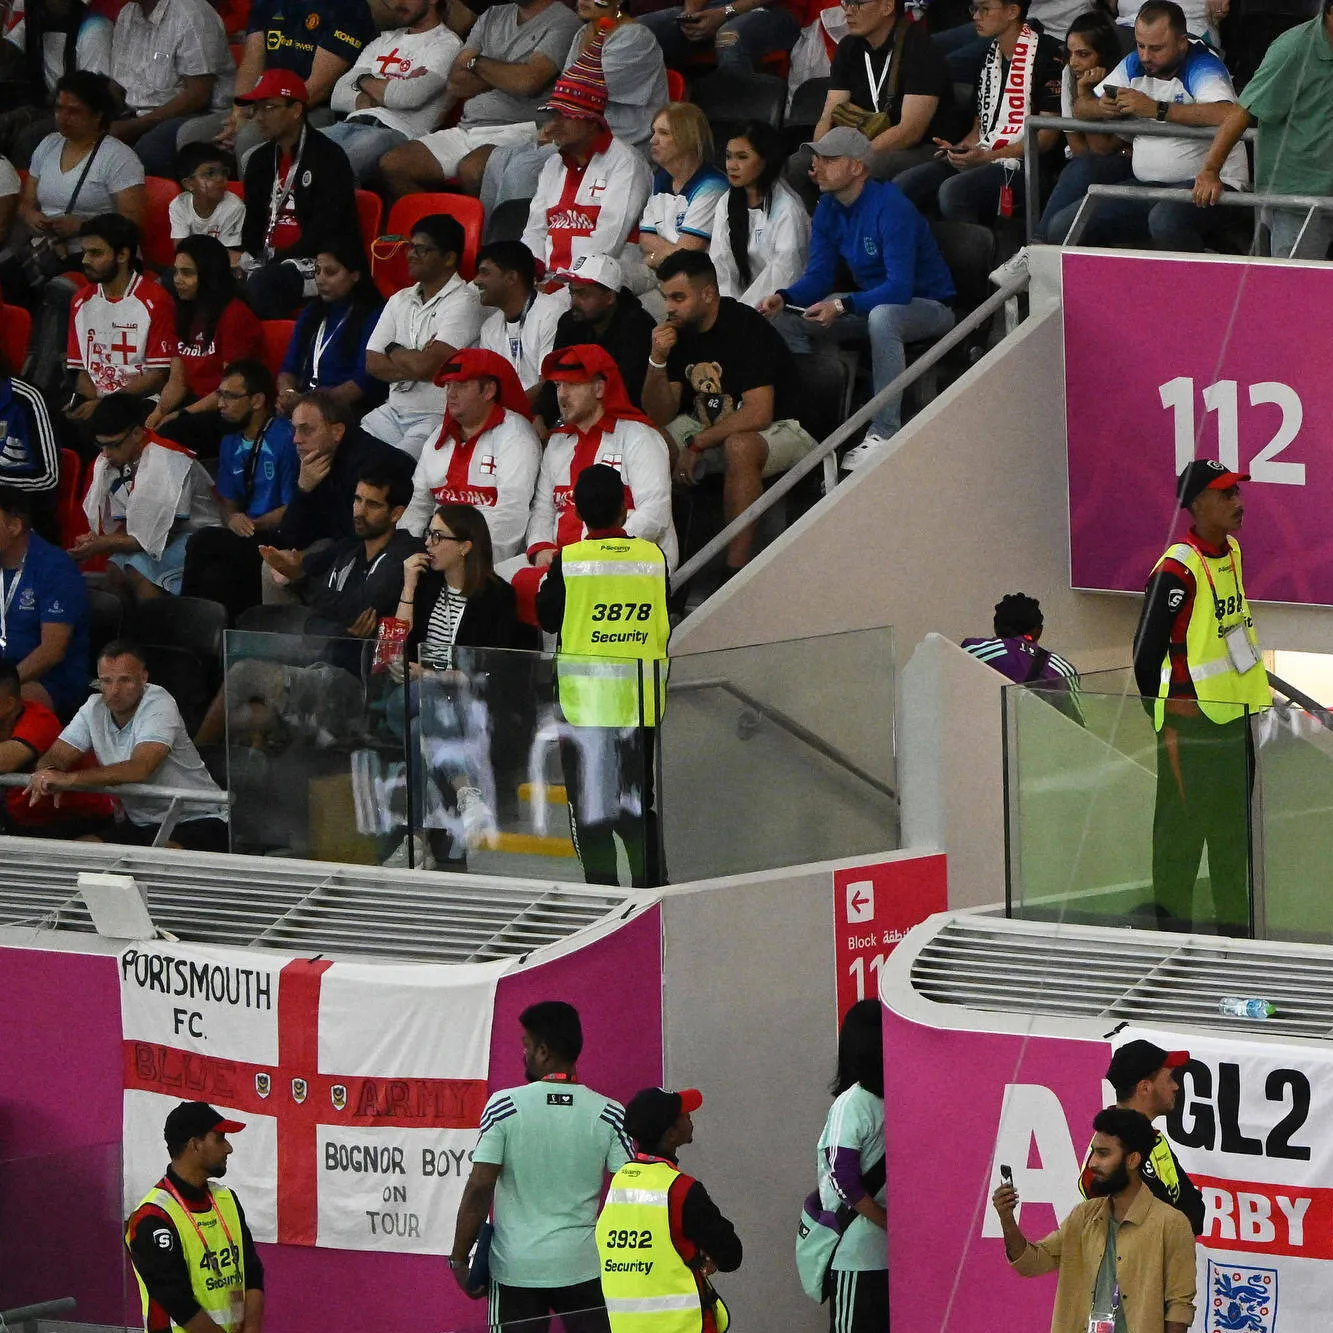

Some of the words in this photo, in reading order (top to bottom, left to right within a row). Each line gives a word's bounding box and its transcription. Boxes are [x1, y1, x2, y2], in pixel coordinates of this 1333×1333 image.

[1158, 376, 1305, 486] 112
[591, 603, 652, 622] 3878
[591, 630, 649, 645] Security
[848, 933, 877, 950] Block
[121, 950, 271, 1010] PORTSMOUTH
[849, 953, 885, 1001] 11
[134, 1043, 236, 1099] BLUE
[353, 1079, 482, 1118] ARMY
[325, 1142, 407, 1176] BOGNOR
[383, 1185, 407, 1203] ON
[366, 1211, 420, 1238] TOUR
[1203, 1188, 1311, 1247] RBY
[606, 1230, 653, 1249] 3932
[604, 1259, 654, 1276] Security
